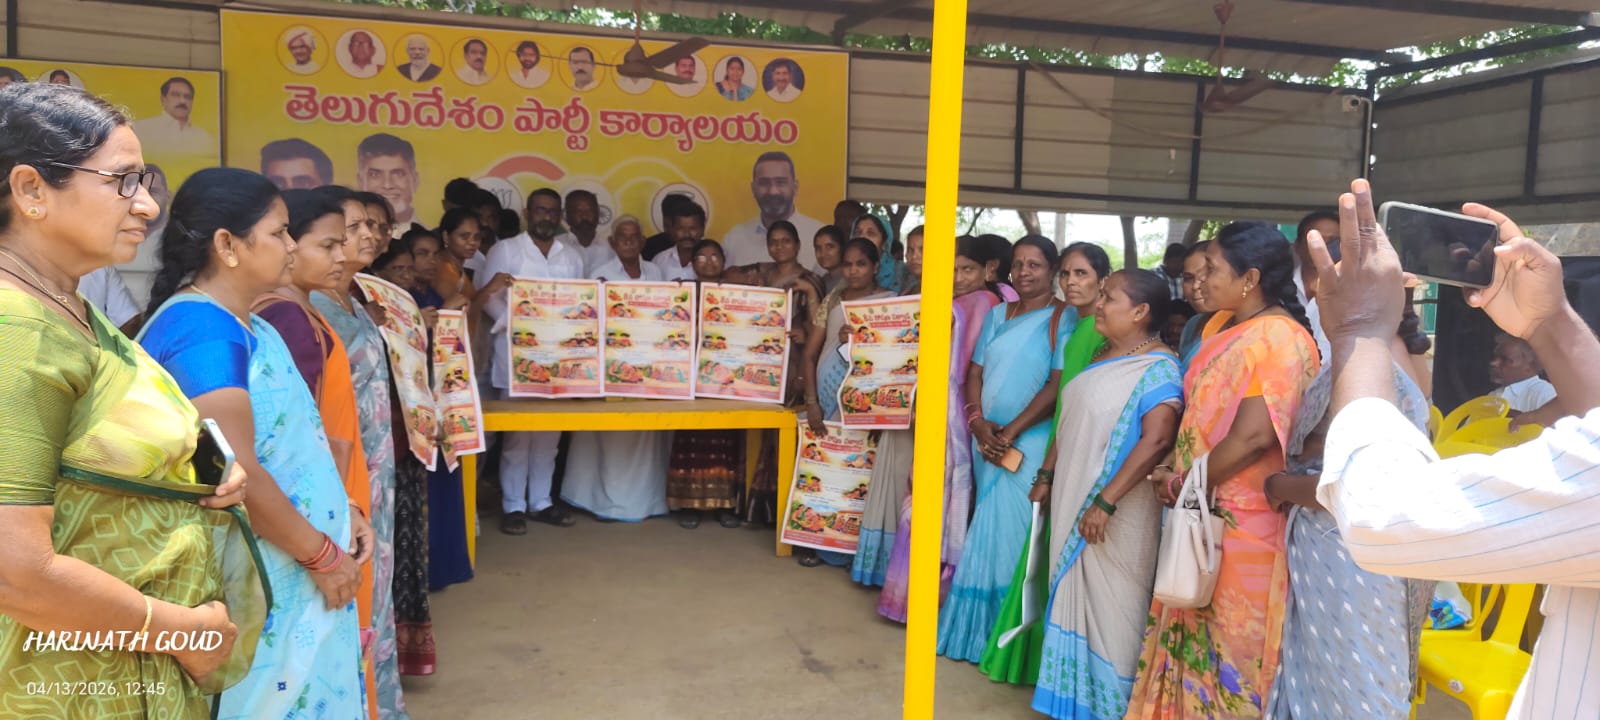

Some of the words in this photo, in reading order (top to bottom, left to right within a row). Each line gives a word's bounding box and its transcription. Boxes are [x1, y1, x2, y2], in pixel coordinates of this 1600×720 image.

[284, 85, 505, 131] తెలుగుదేశం
[513, 97, 590, 151] పార్టీ
[599, 110, 799, 152] కార్యాలయం
